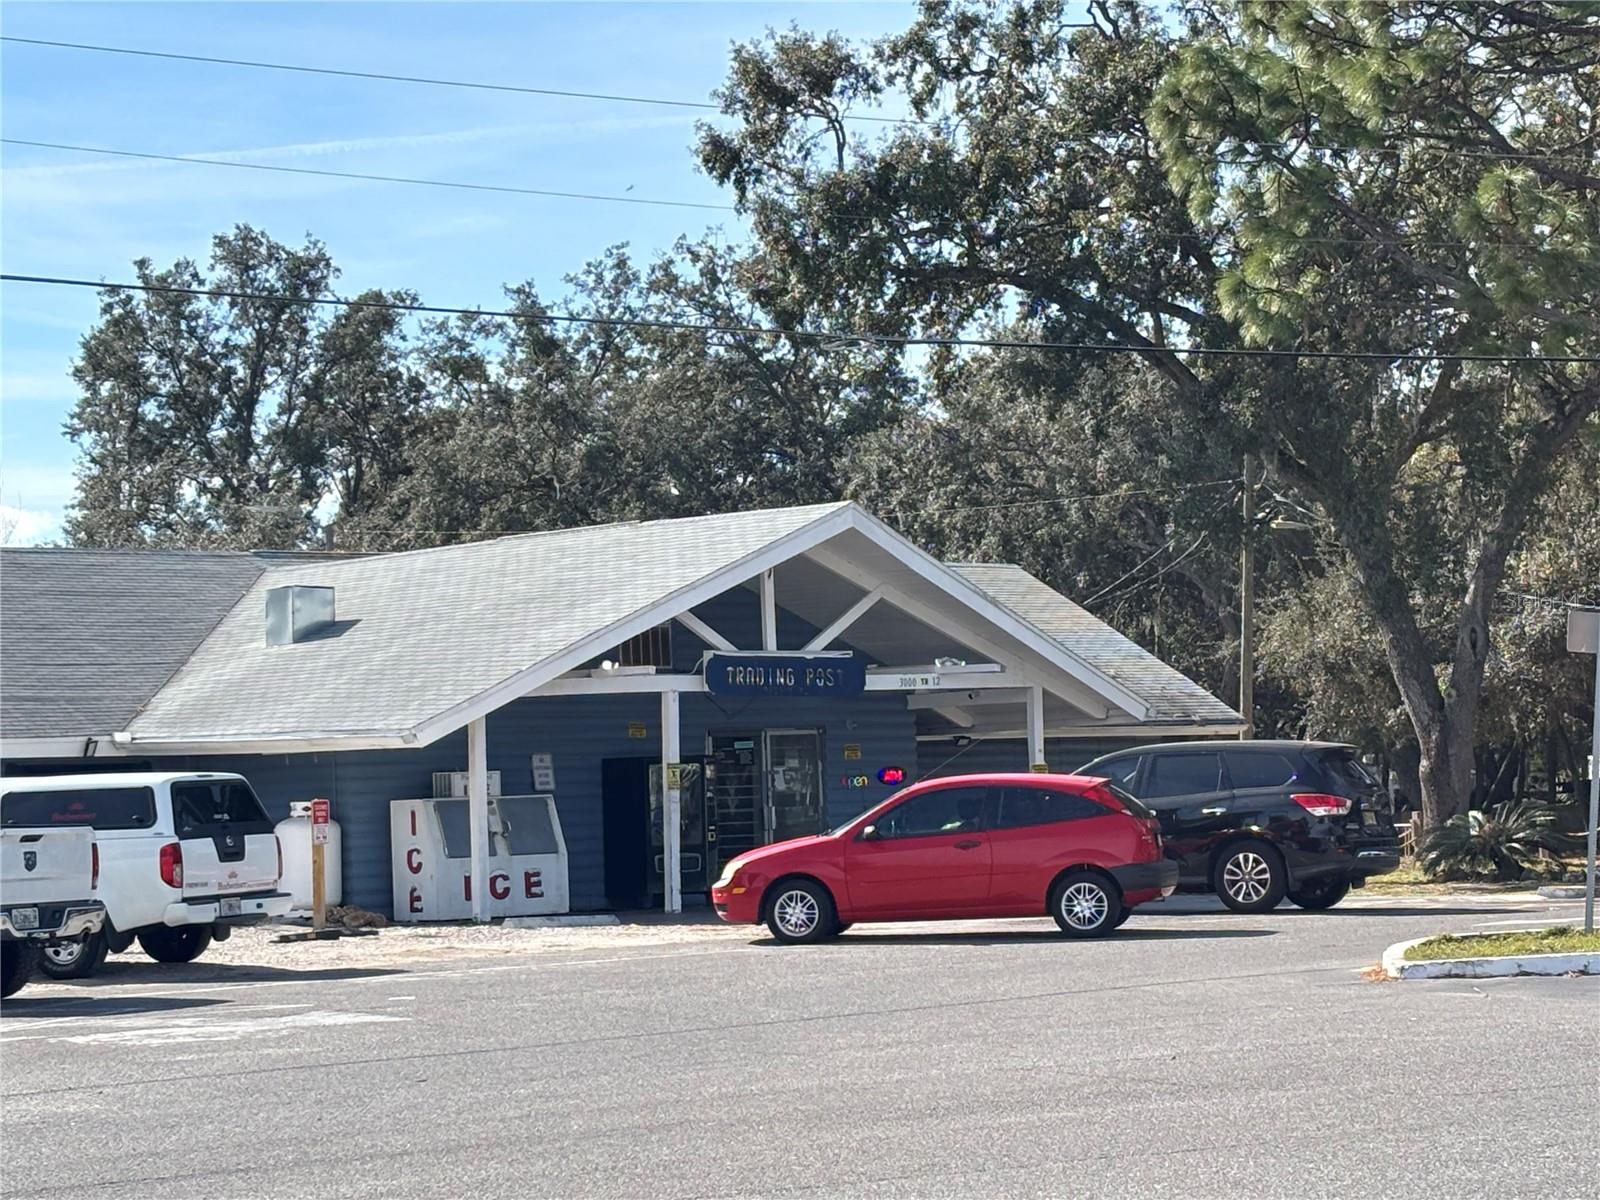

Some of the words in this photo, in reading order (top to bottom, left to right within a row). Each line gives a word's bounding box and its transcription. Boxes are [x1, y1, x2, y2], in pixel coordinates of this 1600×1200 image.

[726, 666, 795, 687] TRADING
[806, 668, 844, 687] POST
[407, 809, 423, 913] ICE
[464, 870, 544, 902] ICE
